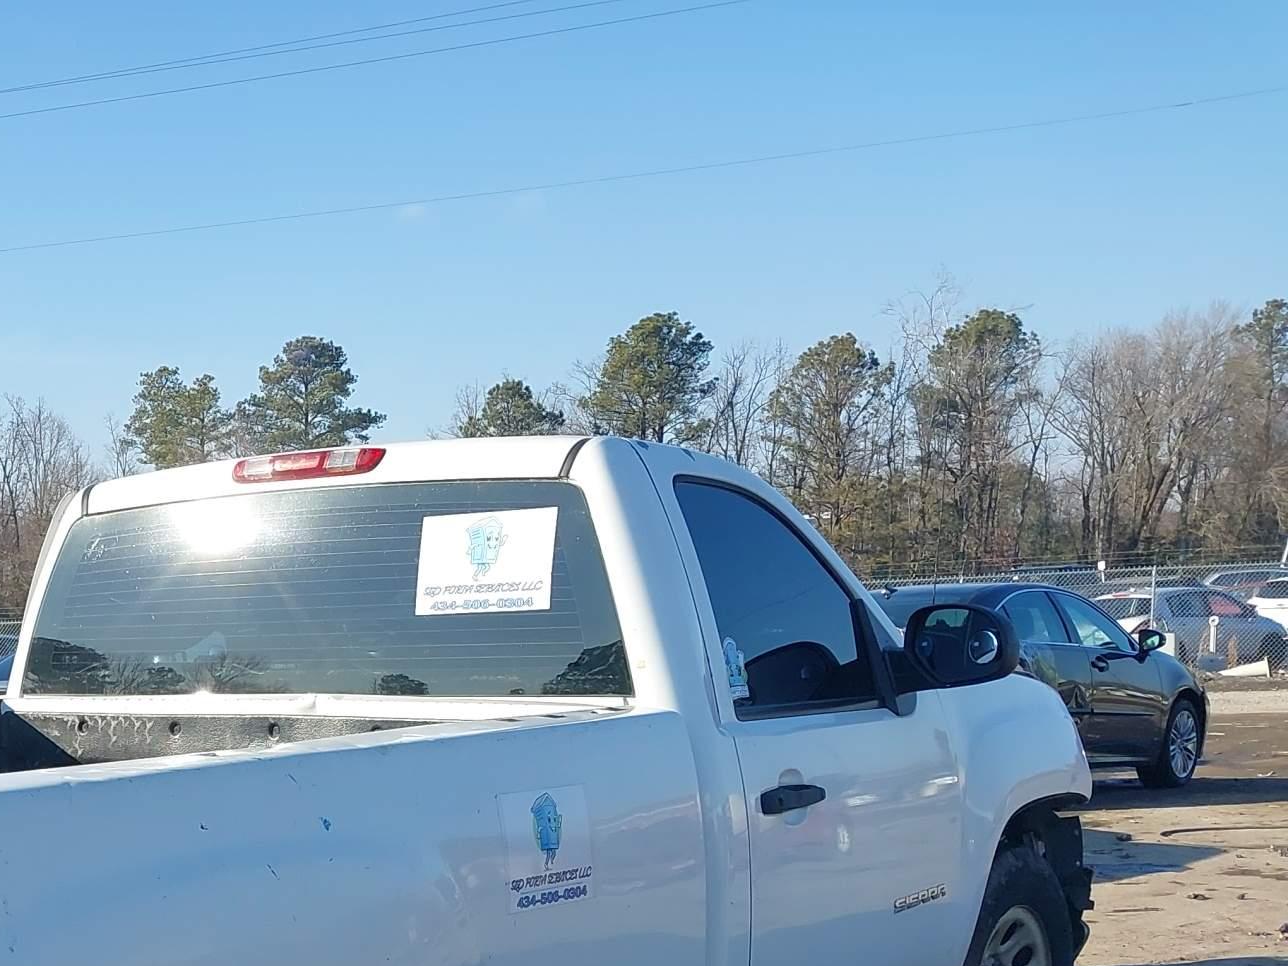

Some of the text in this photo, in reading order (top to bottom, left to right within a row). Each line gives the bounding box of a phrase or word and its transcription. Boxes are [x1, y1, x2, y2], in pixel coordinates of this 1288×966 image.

[443, 584, 473, 596] PORTA
[474, 581, 521, 595] SERVICES
[521, 580, 544, 592] LLC
[430, 597, 534, 611] 434-506-0304
[524, 873, 547, 889] PORTA
[547, 868, 579, 884] SERVICES
[579, 865, 593, 879] LLC
